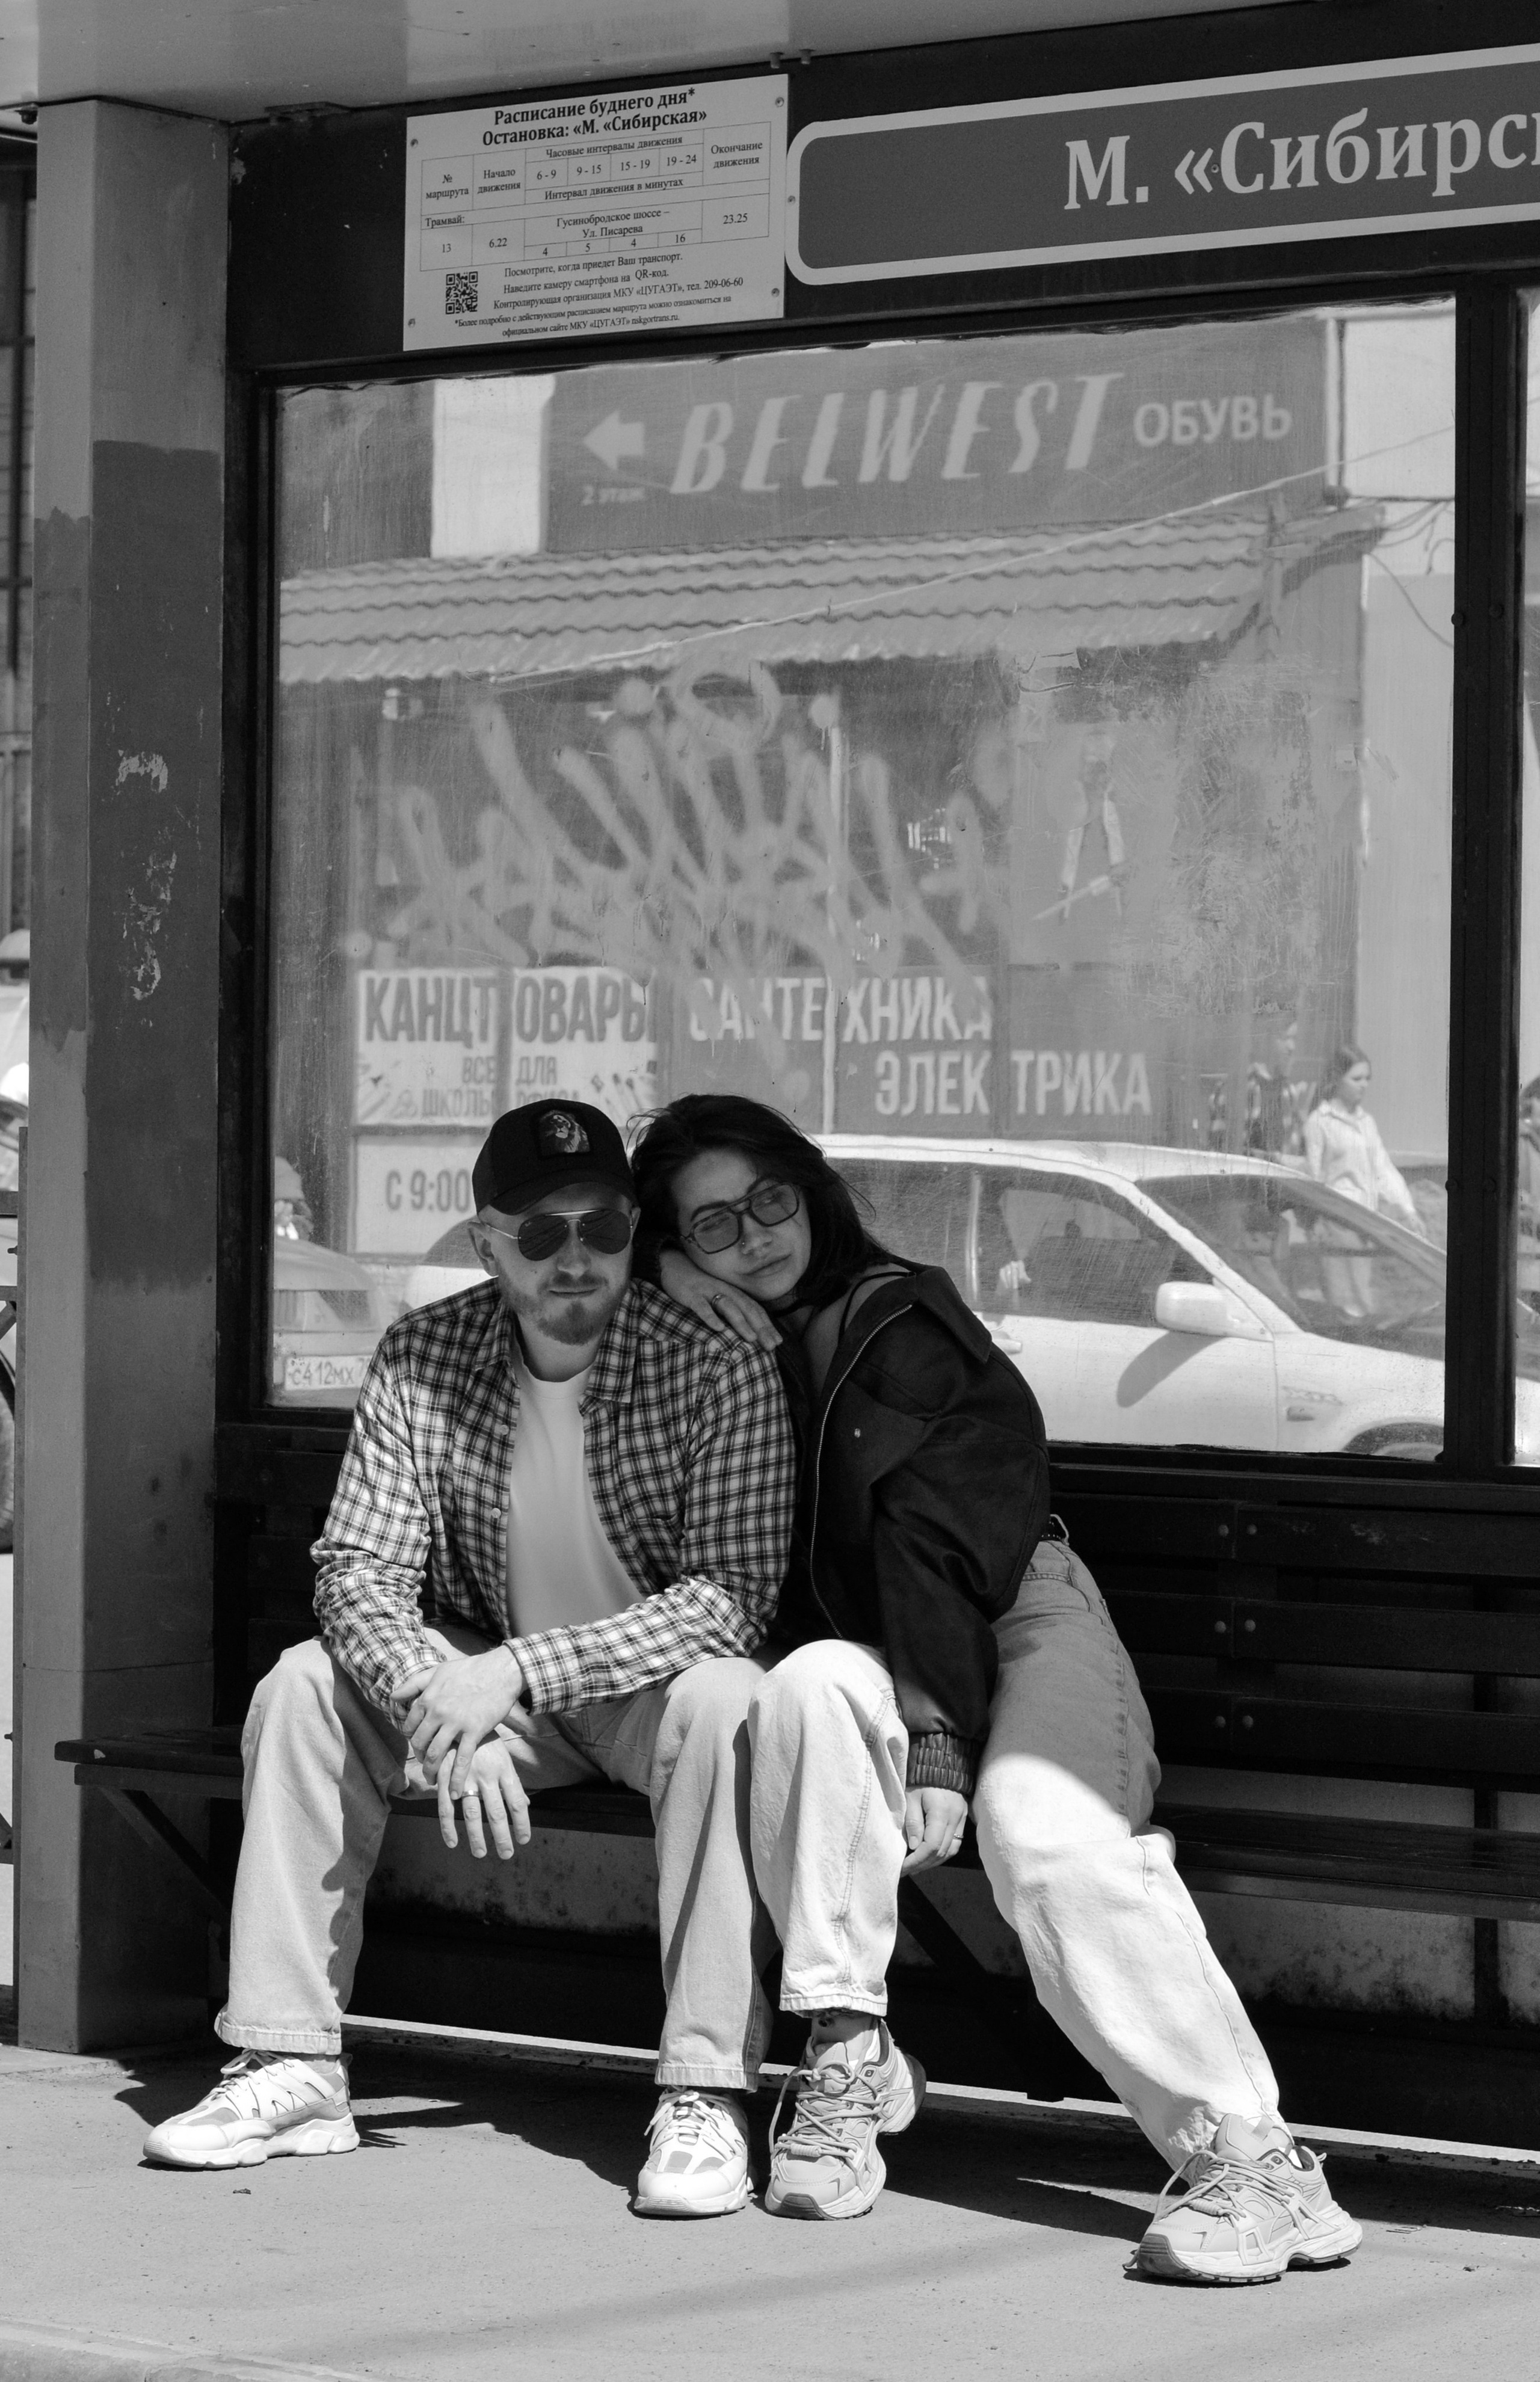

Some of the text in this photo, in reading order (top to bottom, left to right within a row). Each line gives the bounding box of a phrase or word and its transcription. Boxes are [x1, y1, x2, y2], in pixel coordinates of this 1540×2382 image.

[494, 104, 585, 125] Расписание
[590, 96, 653, 116] буднего
[482, 111, 707, 146] Остановка: «М. «Сибирская»
[546, 136, 682, 158] Часовые интервалы движения
[711, 143, 763, 154] Окончание
[621, 161, 630, 171] 15
[640, 159, 650, 169] 19
[667, 157, 677, 167] 19
[686, 155, 697, 164] 24
[713, 157, 760, 169] движения
[1064, 107, 1540, 211] М. «Сибирс
[484, 168, 516, 179] Начало
[537, 171, 542, 180] 6
[550, 170, 556, 179] 9
[576, 167, 582, 176] 9
[592, 165, 602, 174] 15
[442, 174, 452, 184] №
[426, 188, 469, 200] маршрута
[478, 182, 521, 194] движения
[545, 189, 587, 200] Интервал
[590, 183, 634, 196] движения
[645, 179, 683, 190] минутах
[425, 215, 465, 229] Трамвай:
[557, 214, 630, 229] Гусинобродское
[633, 210, 661, 219] шоссе
[723, 213, 748, 224] 23.25
[583, 226, 643, 238] Ул. Писарева
[489, 238, 507, 248] 6.22
[631, 238, 636, 247] 4
[675, 233, 686, 244] 16
[442, 244, 451, 253] 13
[543, 247, 548, 256] 4
[585, 243, 591, 252] 5
[505, 253, 683, 278] Посмотрите, когда приедет Ваш транспорт.
[504, 283, 541, 294] Наведите
[544, 280, 571, 291] камеру
[574, 276, 618, 288] смартфона
[635, 269, 669, 280] QR-код.
[494, 296, 561, 310] Контролирующая
[564, 291, 611, 304] организация
[613, 287, 633, 298] МКУ
[686, 282, 701, 291] тел.
[704, 277, 744, 289] 209-06-60
[479, 315, 511, 327] подробно
[518, 310, 565, 323] действующим
[567, 306, 611, 319] расписанием
[613, 304, 647, 316] маршрута
[649, 301, 672, 309] можно
[674, 297, 721, 307] ознакомиться
[502, 325, 548, 337] официальном
[550, 324, 568, 332] сайте
[570, 321, 588, 330] МКУ
[1134, 393, 1293, 448] ОБУВЬ
[669, 372, 1125, 494] BELWEST
[462, 1056, 558, 1085] ВСЕ ДЛЯ
